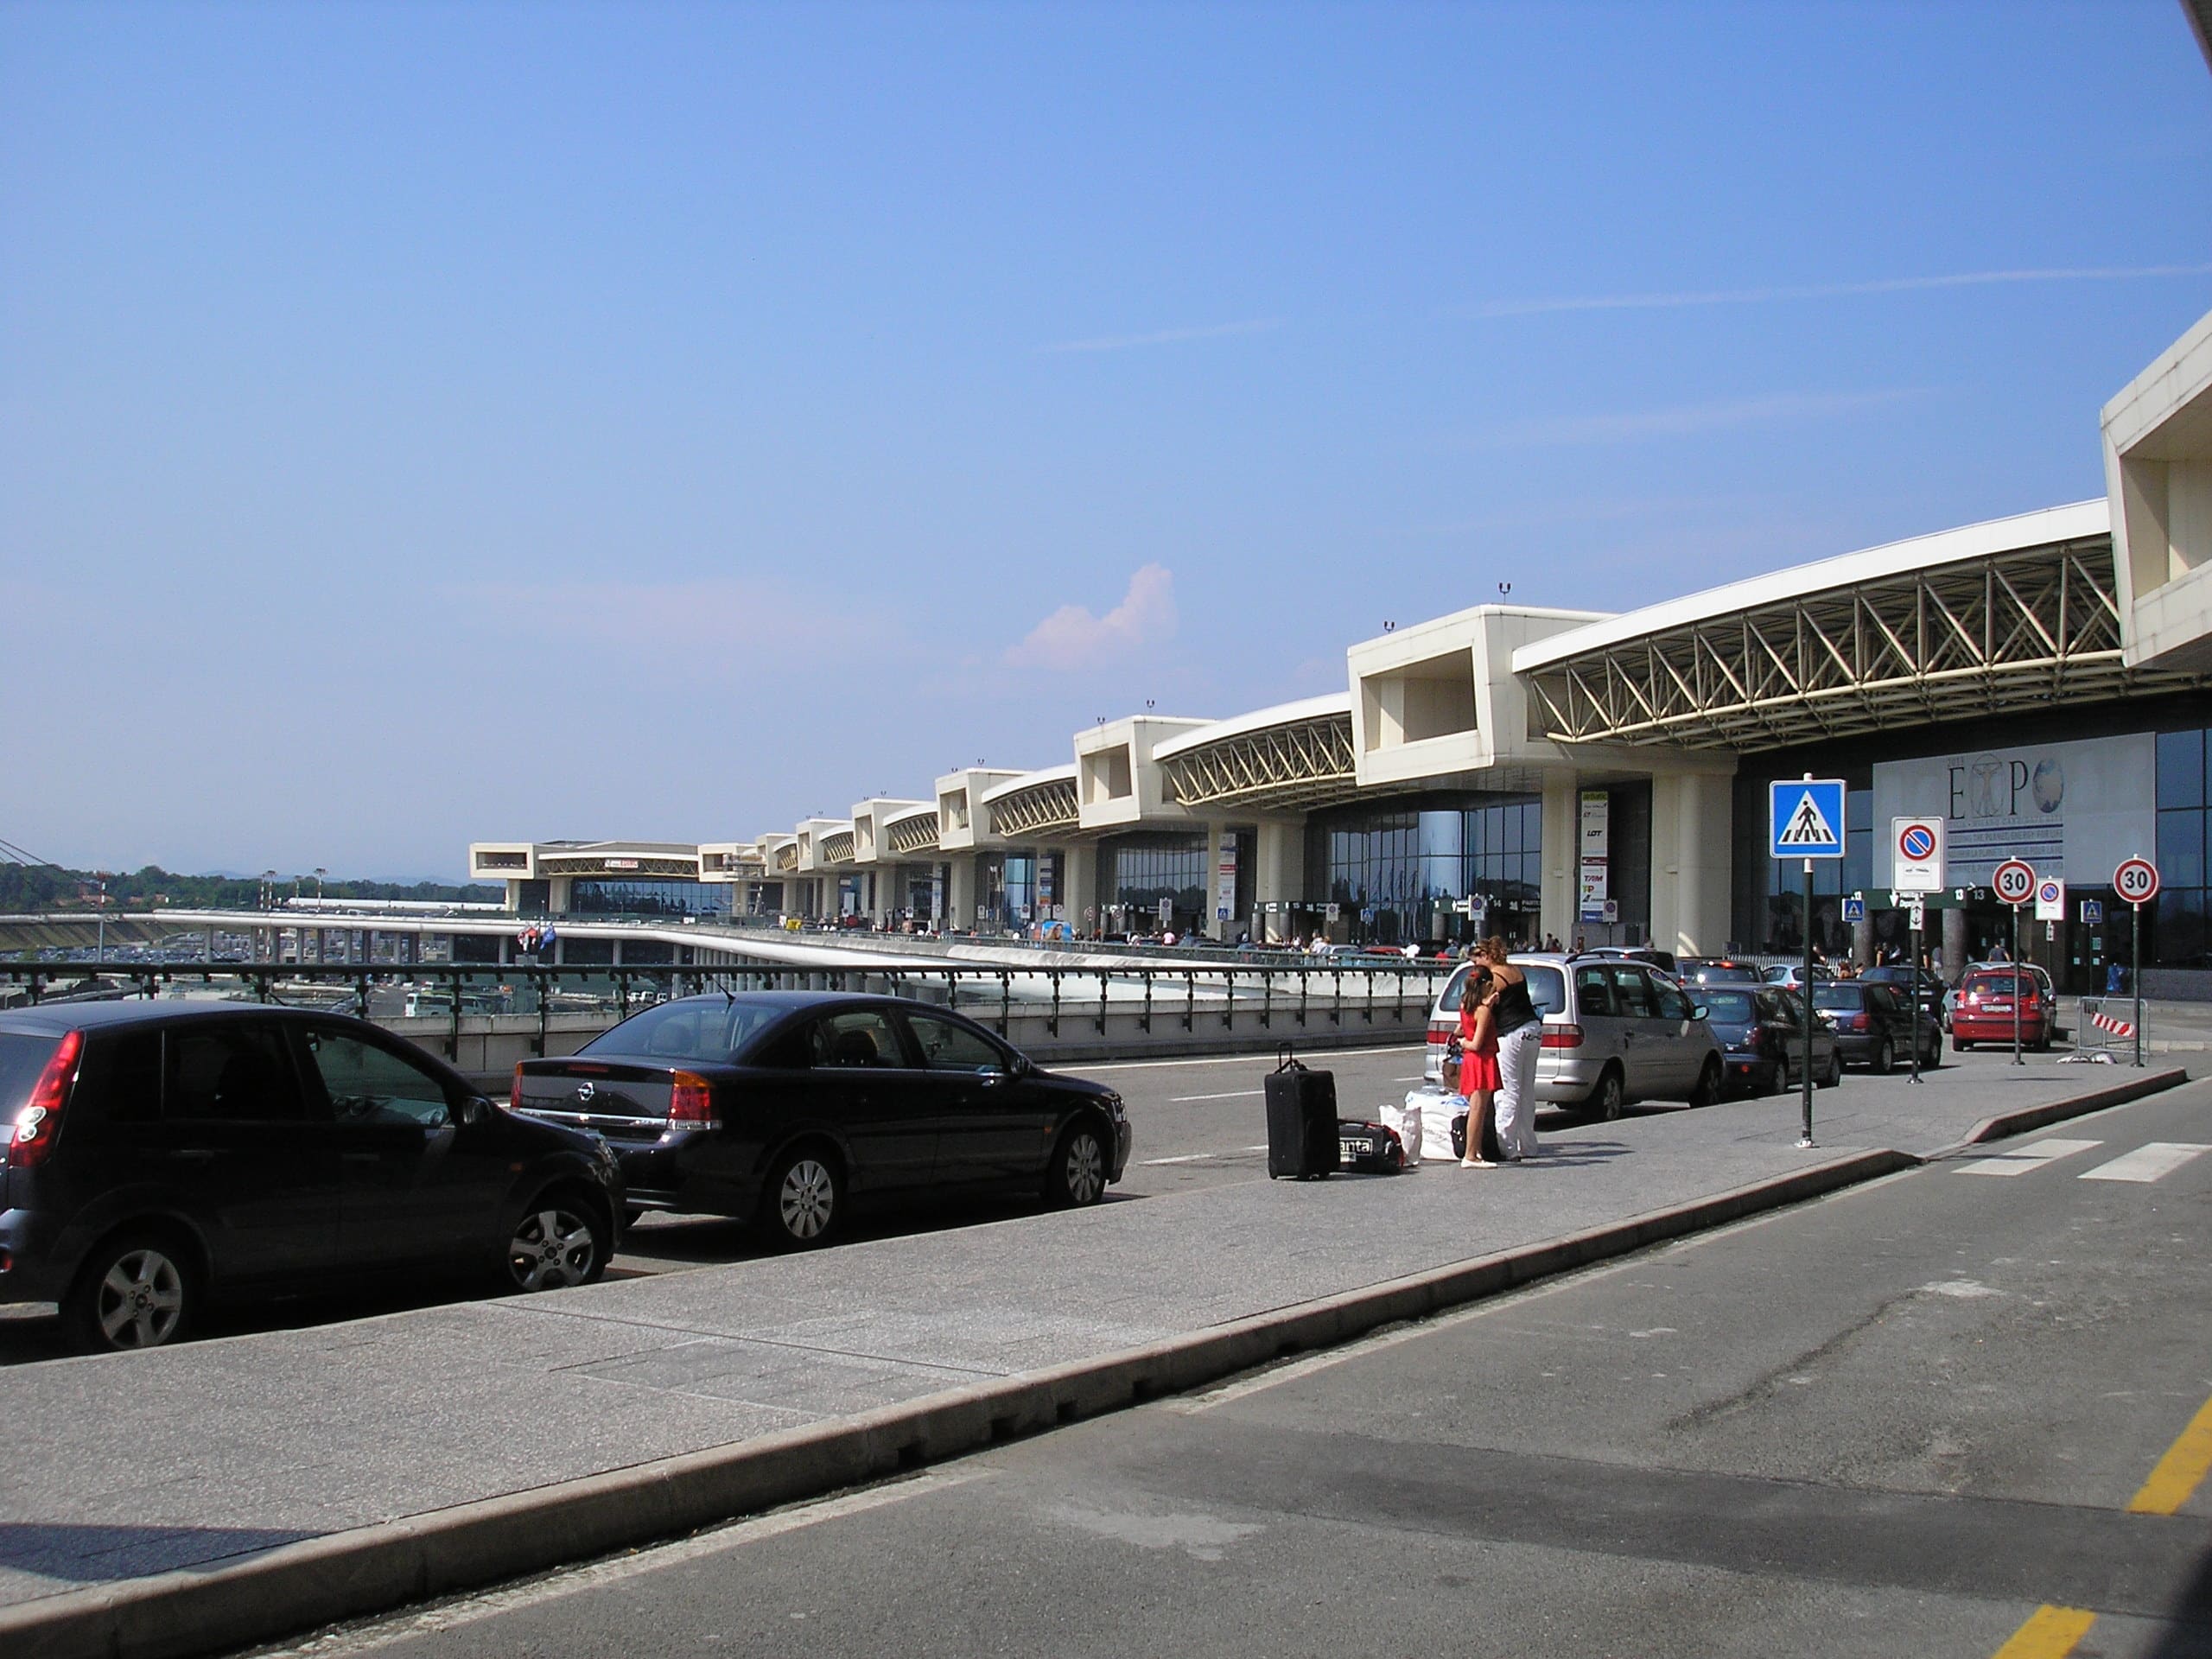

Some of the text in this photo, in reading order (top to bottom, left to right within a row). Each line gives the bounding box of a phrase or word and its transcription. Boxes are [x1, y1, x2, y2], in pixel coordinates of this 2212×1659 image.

[2003, 873, 2026, 891] 30
[2125, 871, 2148, 889] 30
[1974, 889, 1985, 900] 13
